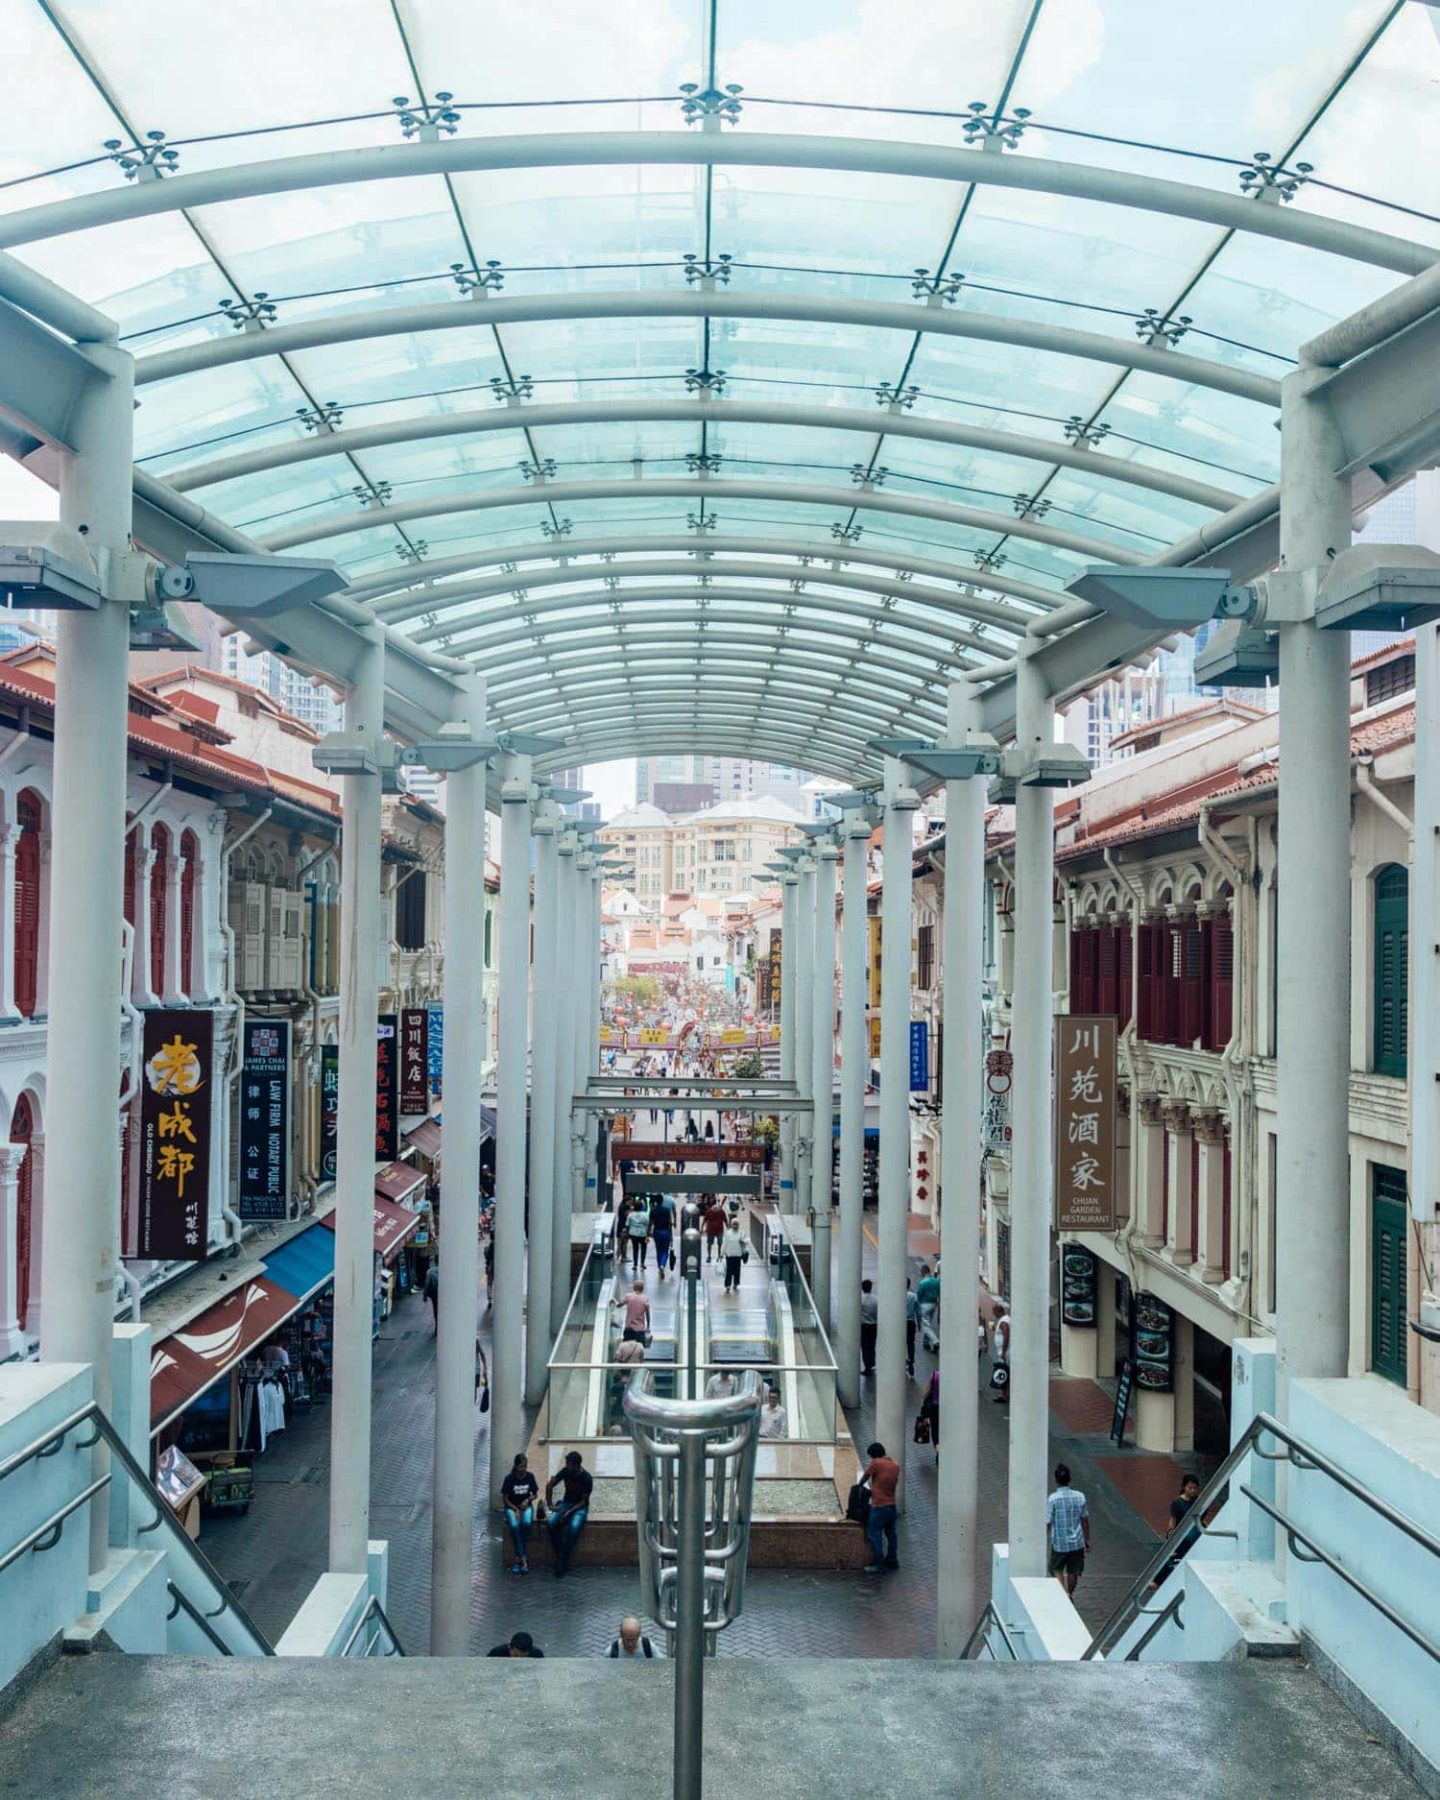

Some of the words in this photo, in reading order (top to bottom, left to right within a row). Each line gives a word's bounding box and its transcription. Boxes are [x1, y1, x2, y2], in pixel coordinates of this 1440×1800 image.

[270, 1080, 281, 1101] LAW
[152, 1034, 206, 1198] 老成都
[269, 1103, 281, 1127] FIRM
[1069, 1025, 1105, 1190] 川苑酒家
[268, 1132, 280, 1165] NOTARY
[268, 1166, 280, 1194] PUBLIC
[1070, 1206, 1101, 1214] GARDEN
[1072, 1197, 1098, 1205] CHUAN
[1062, 1214, 1109, 1223] RESTAURANT
